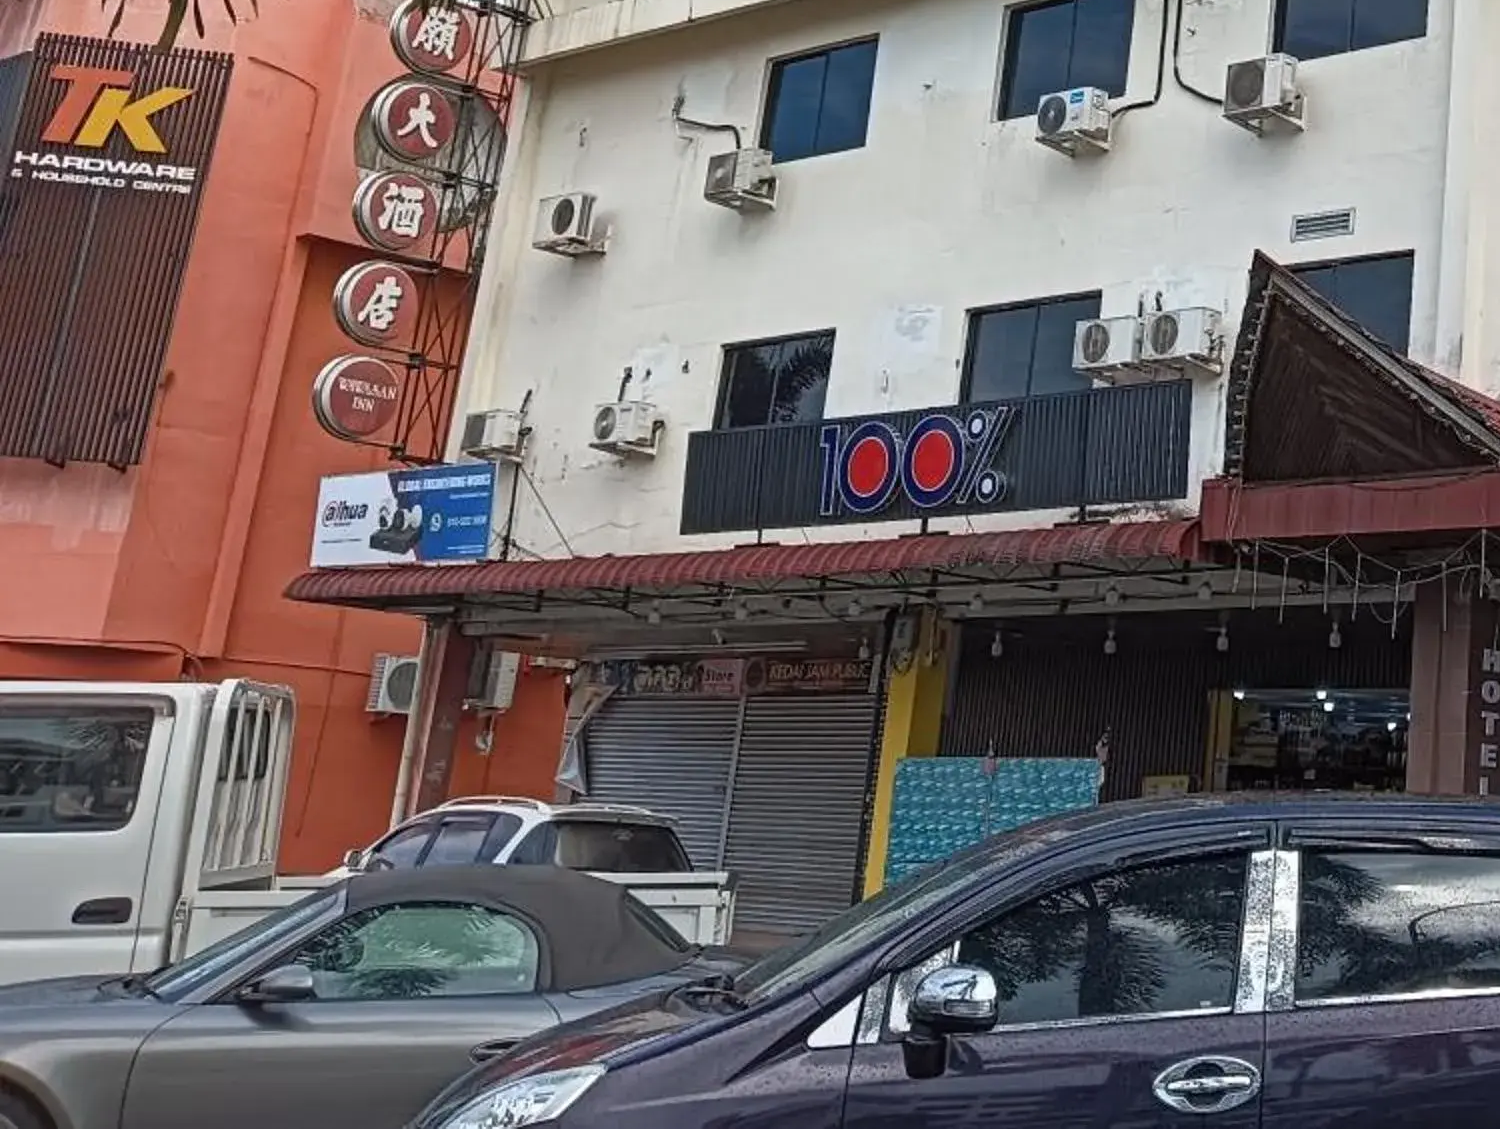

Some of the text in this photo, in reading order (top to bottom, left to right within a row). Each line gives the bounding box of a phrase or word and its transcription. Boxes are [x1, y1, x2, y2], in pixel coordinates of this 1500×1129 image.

[41, 65, 194, 153] TK
[14, 151, 196, 180] HARDWARE
[32, 170, 125, 188] HOUSEHOLD
[819, 405, 1016, 515] 100%
